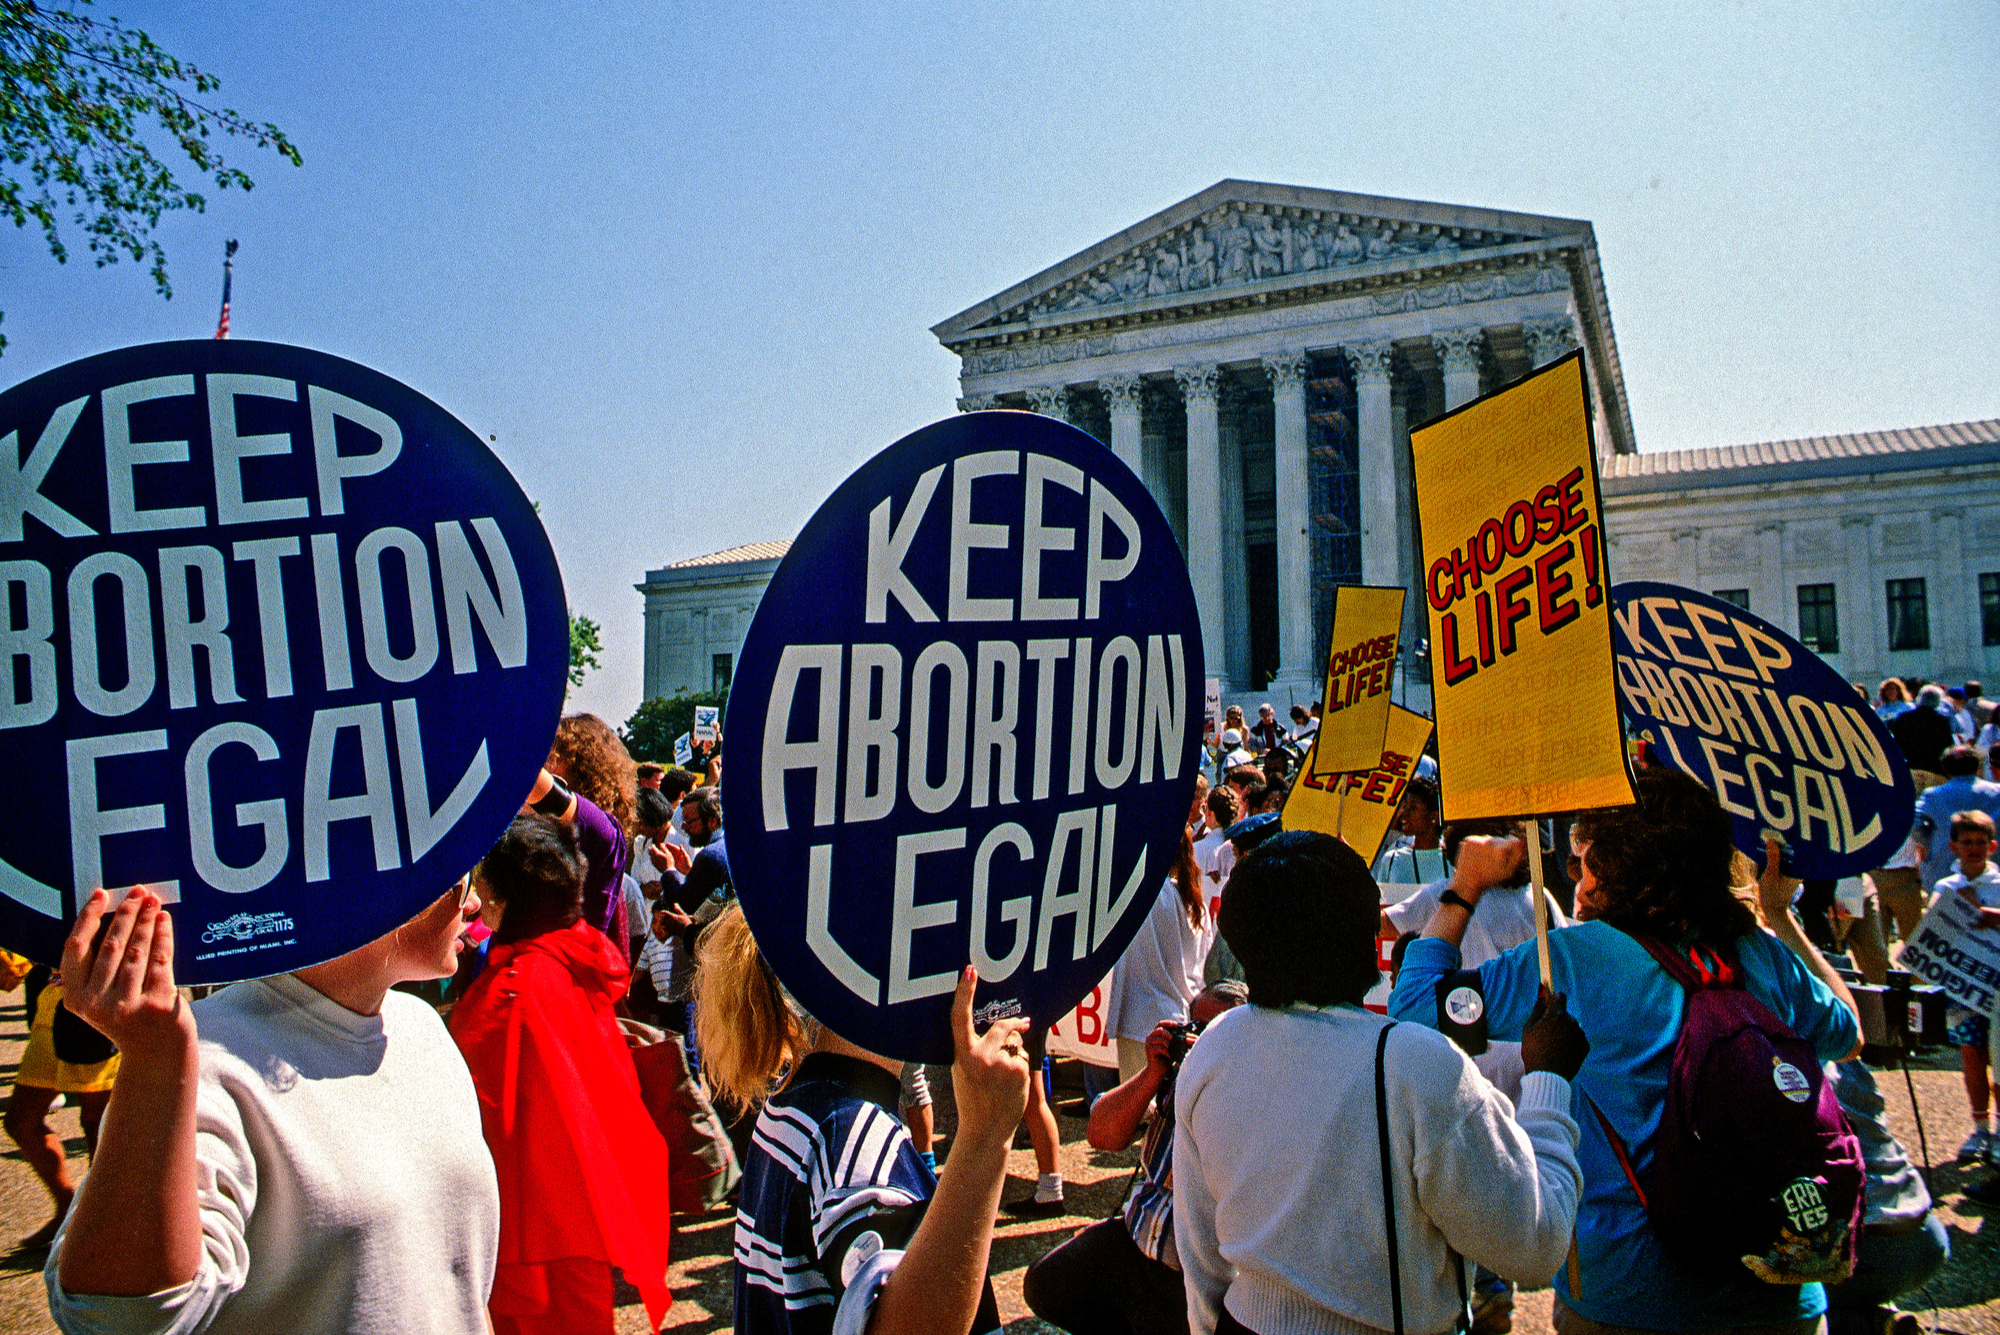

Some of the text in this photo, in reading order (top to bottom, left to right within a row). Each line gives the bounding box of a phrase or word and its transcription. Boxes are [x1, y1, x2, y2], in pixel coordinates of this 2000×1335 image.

[0, 373, 403, 542] KEEP
[865, 450, 1142, 623] KEEP
[1428, 466, 1589, 610] CHOOSE
[0, 516, 528, 730] BORTION
[1329, 634, 1396, 678] CHOOSE
[1441, 524, 1603, 687] LIFE!
[1614, 597, 1793, 683] KEEP
[762, 634, 1187, 832] ABORTION
[1329, 658, 1395, 714] LIFE!
[1618, 655, 1895, 787] ABORTION
[1659, 725, 1883, 855] LEGAL
[217, 947, 248, 957] PRINTING
[274, 918, 294, 932] 1175
[806, 804, 1147, 1006] LEGAL
[1782, 1182, 1822, 1213] ERA
[1786, 1205, 1829, 1232] YES
